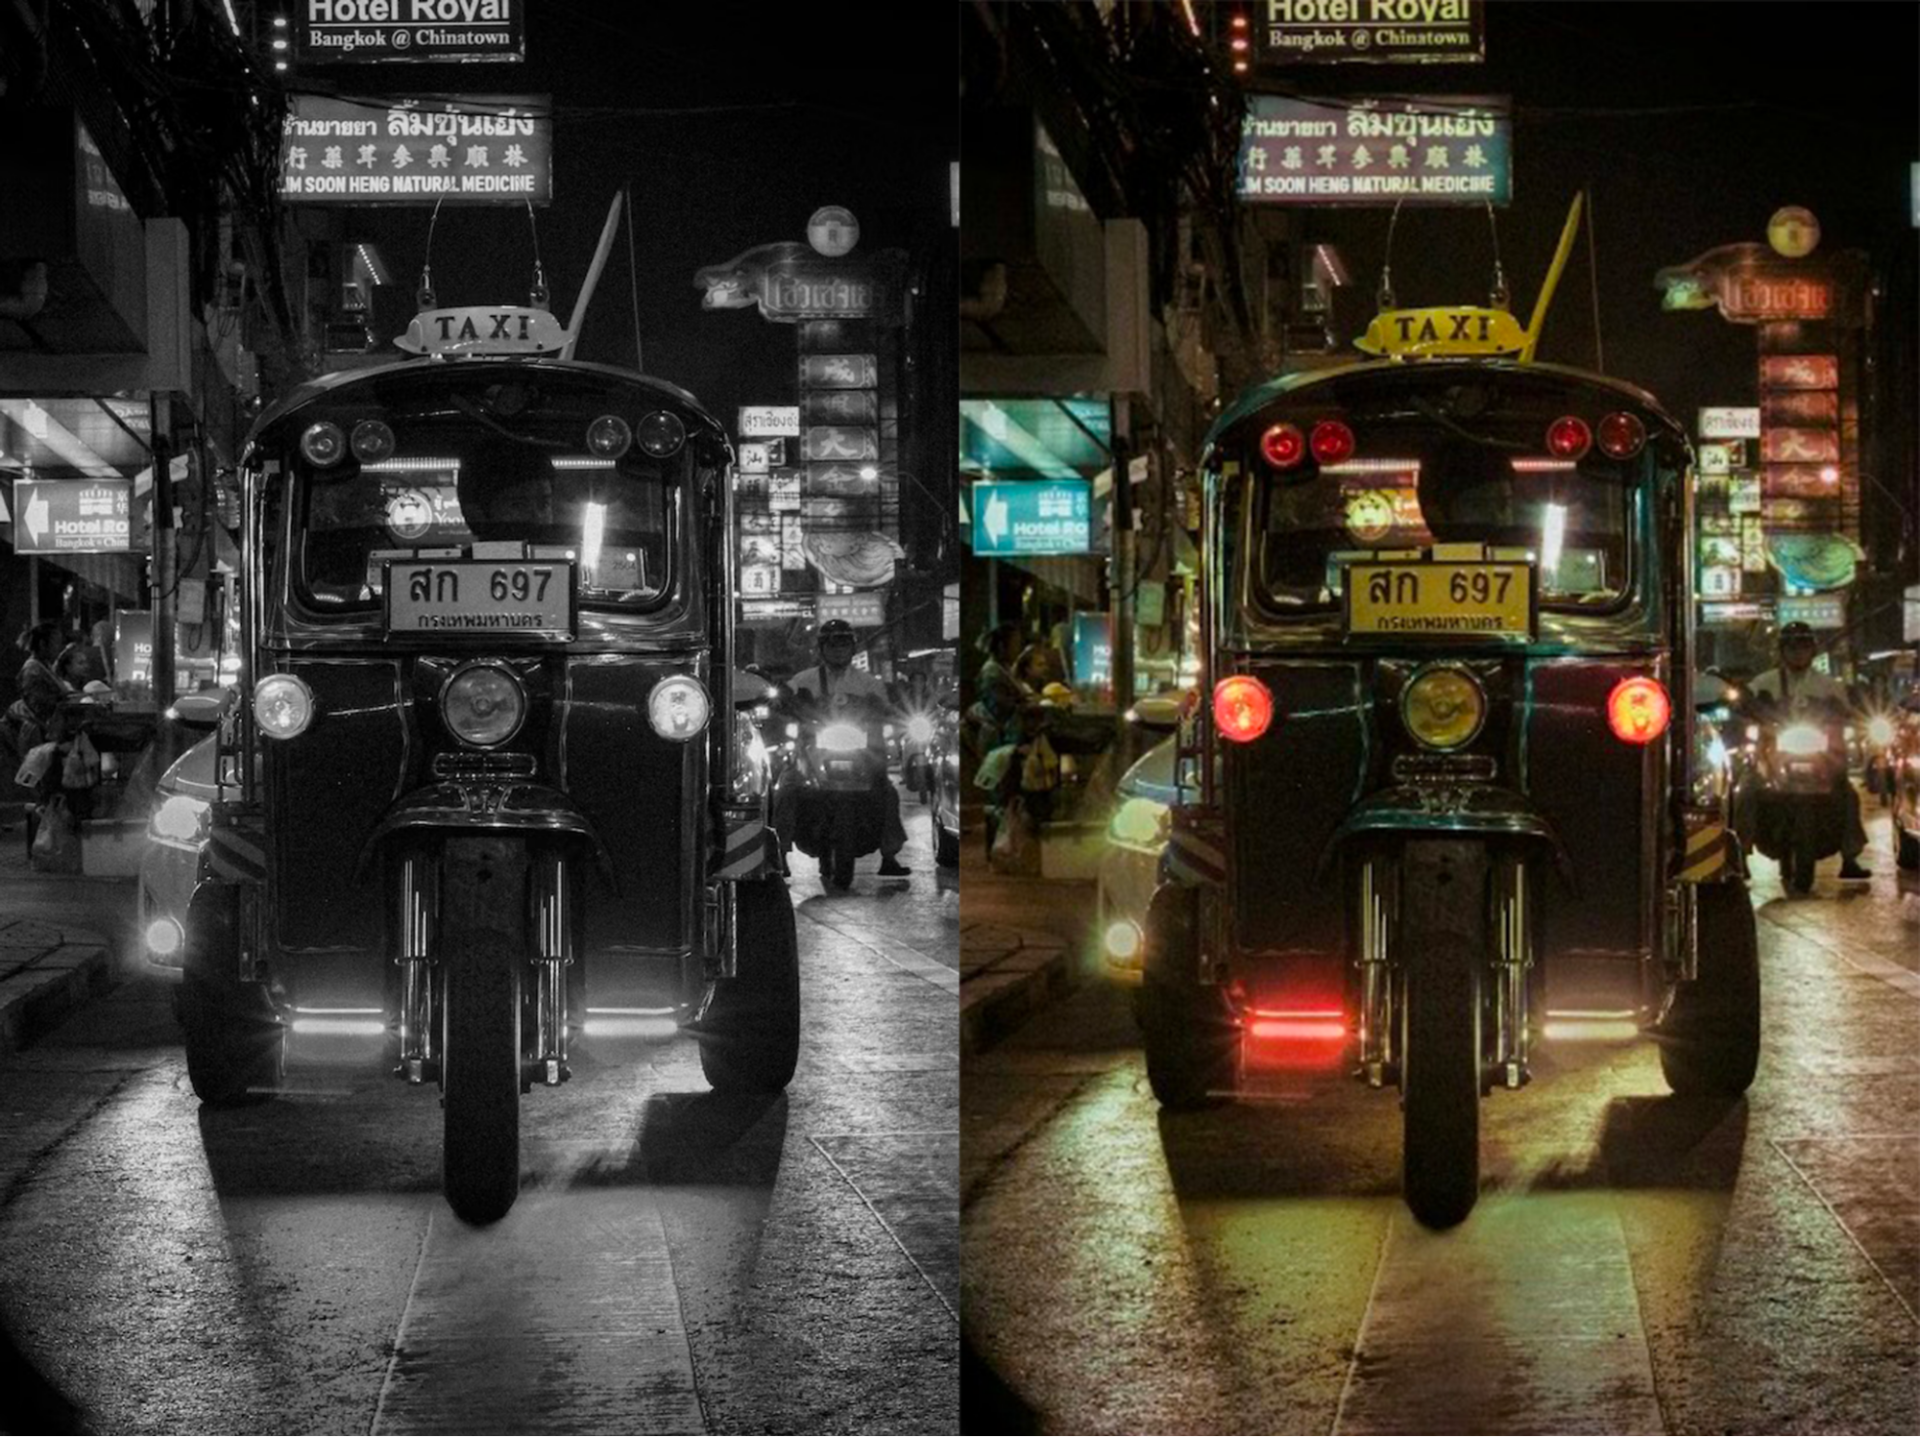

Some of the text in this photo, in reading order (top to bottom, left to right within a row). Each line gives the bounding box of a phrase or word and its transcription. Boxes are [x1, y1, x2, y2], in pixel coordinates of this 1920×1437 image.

[308, 0, 510, 22] Hotel Royal
[1268, 0, 1470, 22] Hotel Royal
[310, 29, 510, 51] Bangkok @ Chinatown
[1269, 29, 1470, 51] Bangkok @ Chinatown
[277, 175, 535, 193] IM SOON HENG NATURAL MEDICINE
[1236, 175, 1495, 194] IM SOON HENG NATURAL MEDICINE
[435, 315, 529, 340] TAXI
[1395, 316, 1489, 341] TAXI
[55, 519, 101, 534] Hotel
[1014, 521, 1059, 535] Hotel
[55, 537, 95, 549] Bangkok
[409, 566, 552, 602] สก 697
[1369, 568, 1513, 604] สก 697
